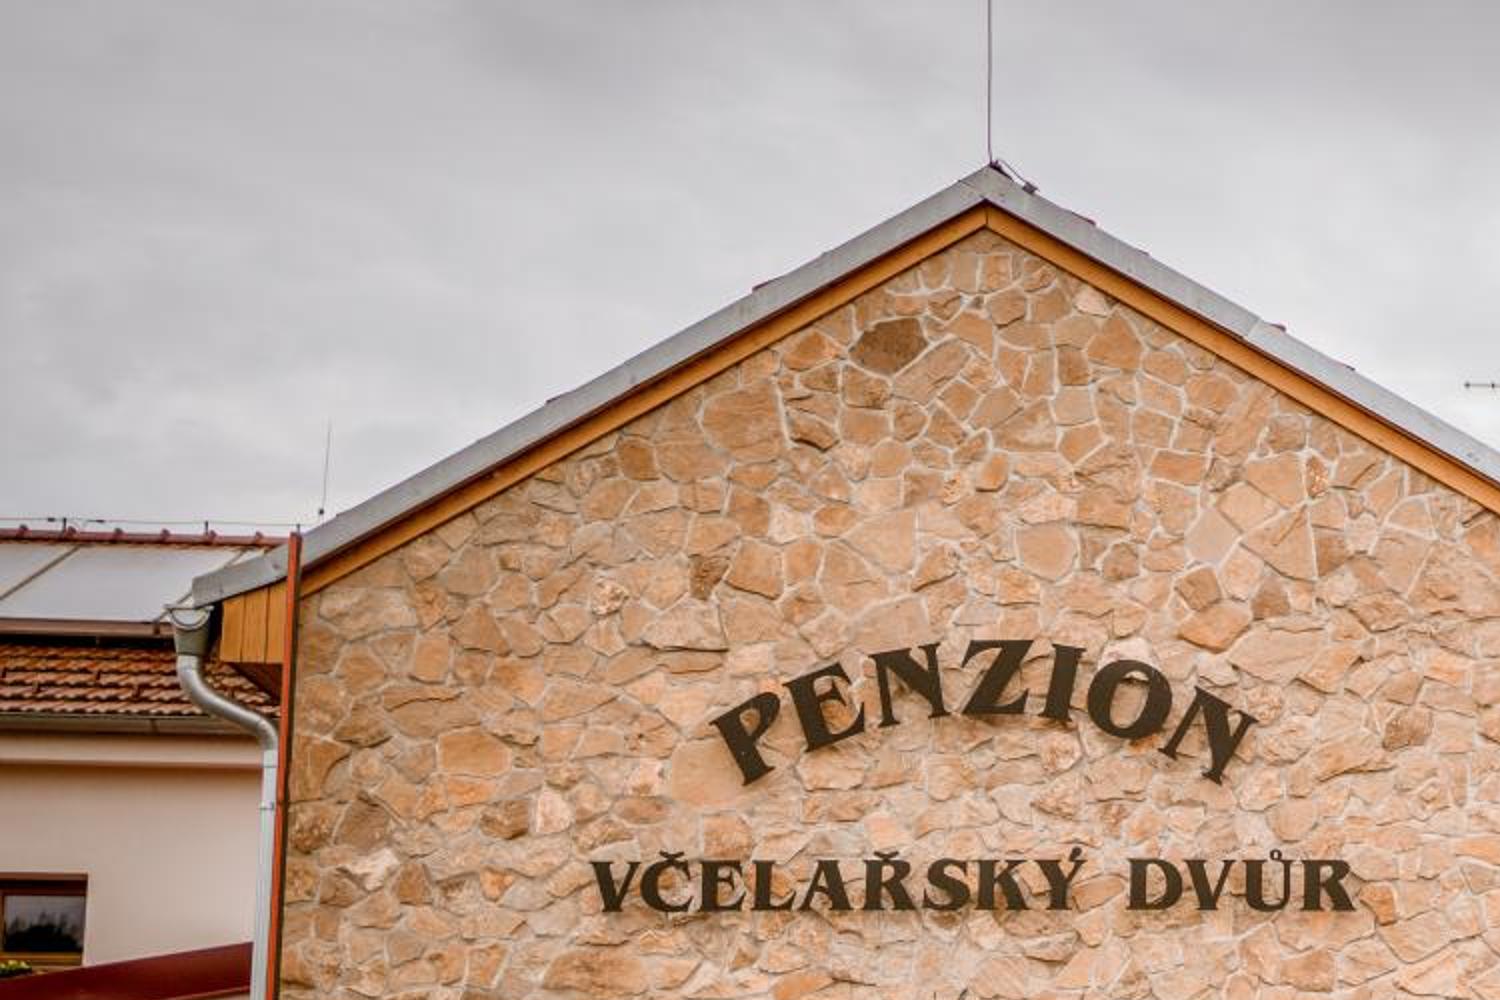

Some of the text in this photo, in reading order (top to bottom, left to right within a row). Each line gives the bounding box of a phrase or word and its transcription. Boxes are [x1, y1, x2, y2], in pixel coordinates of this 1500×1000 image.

[710, 640, 1258, 785] PENZION
[591, 848, 1355, 914] VČELAŘSKÝ DVŮR
